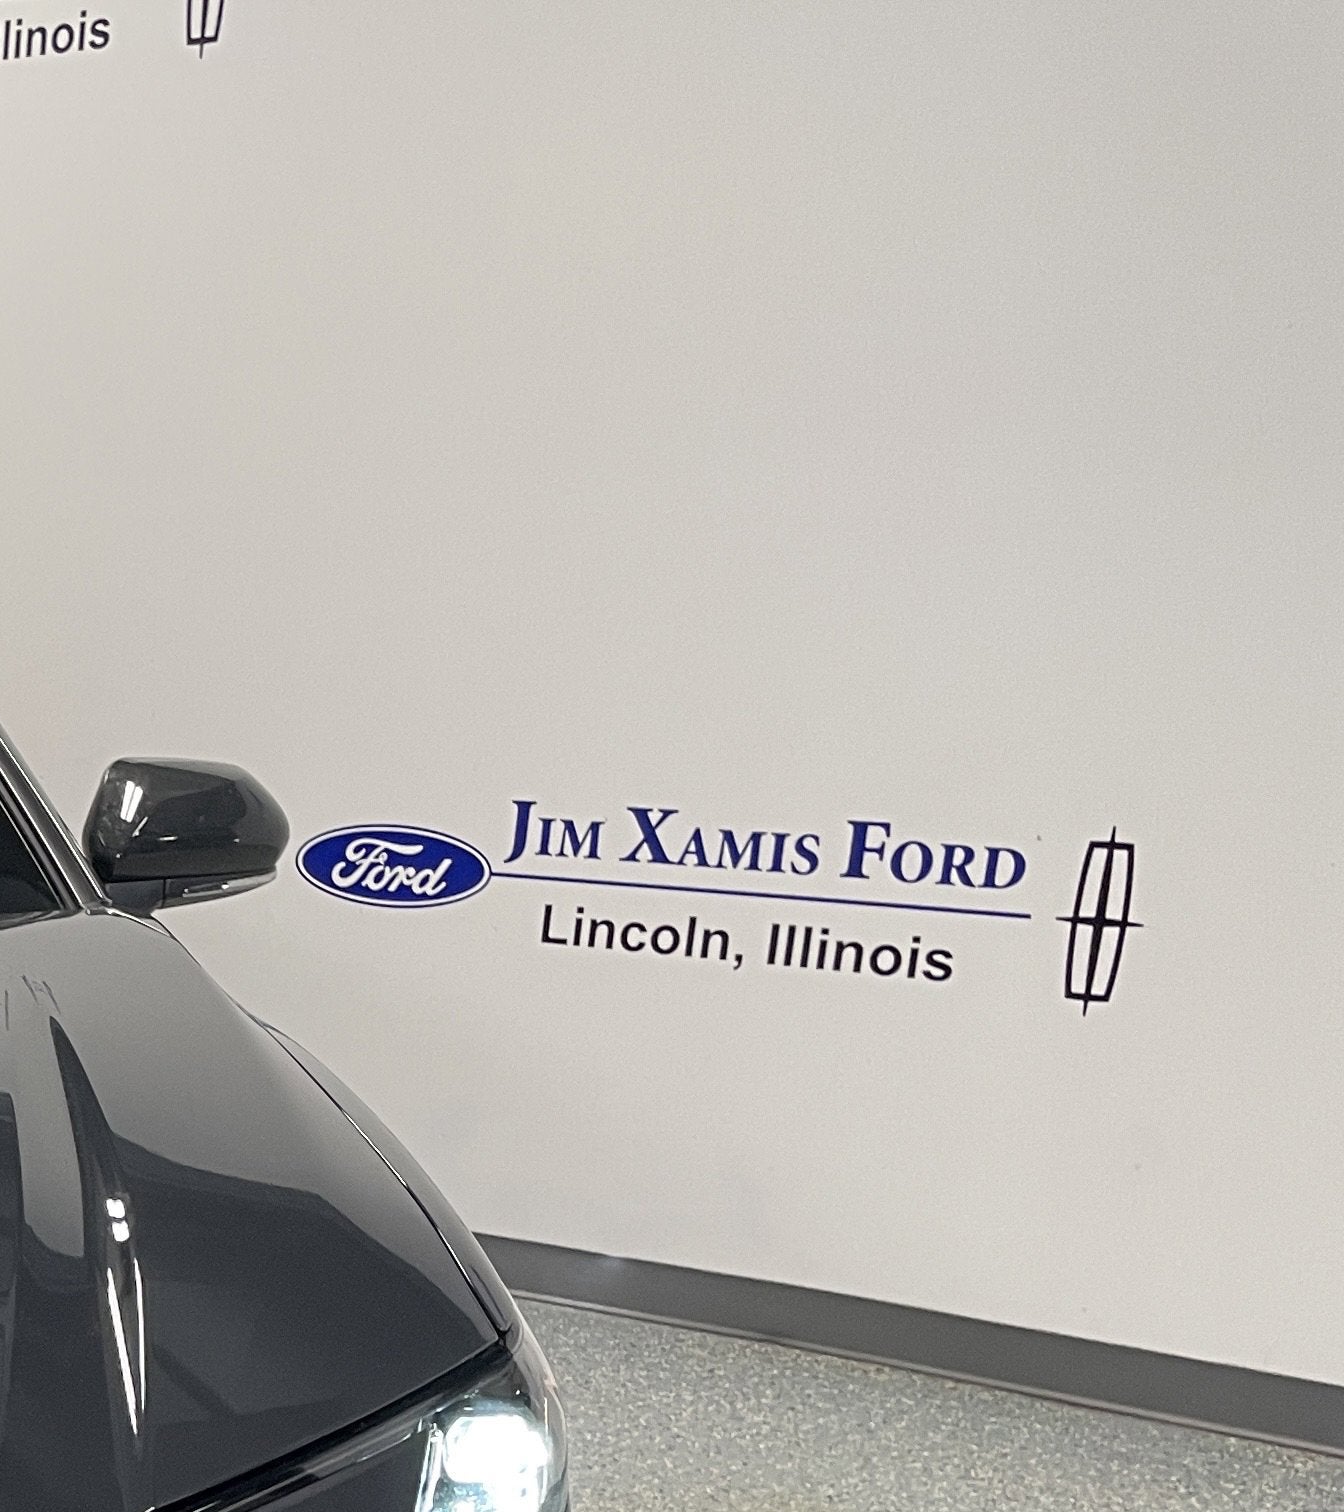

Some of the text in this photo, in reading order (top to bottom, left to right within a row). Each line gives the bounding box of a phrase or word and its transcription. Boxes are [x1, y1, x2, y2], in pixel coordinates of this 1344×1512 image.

[331, 842, 449, 897] Ford
[541, 904, 954, 982] Lincoln, Illinois
